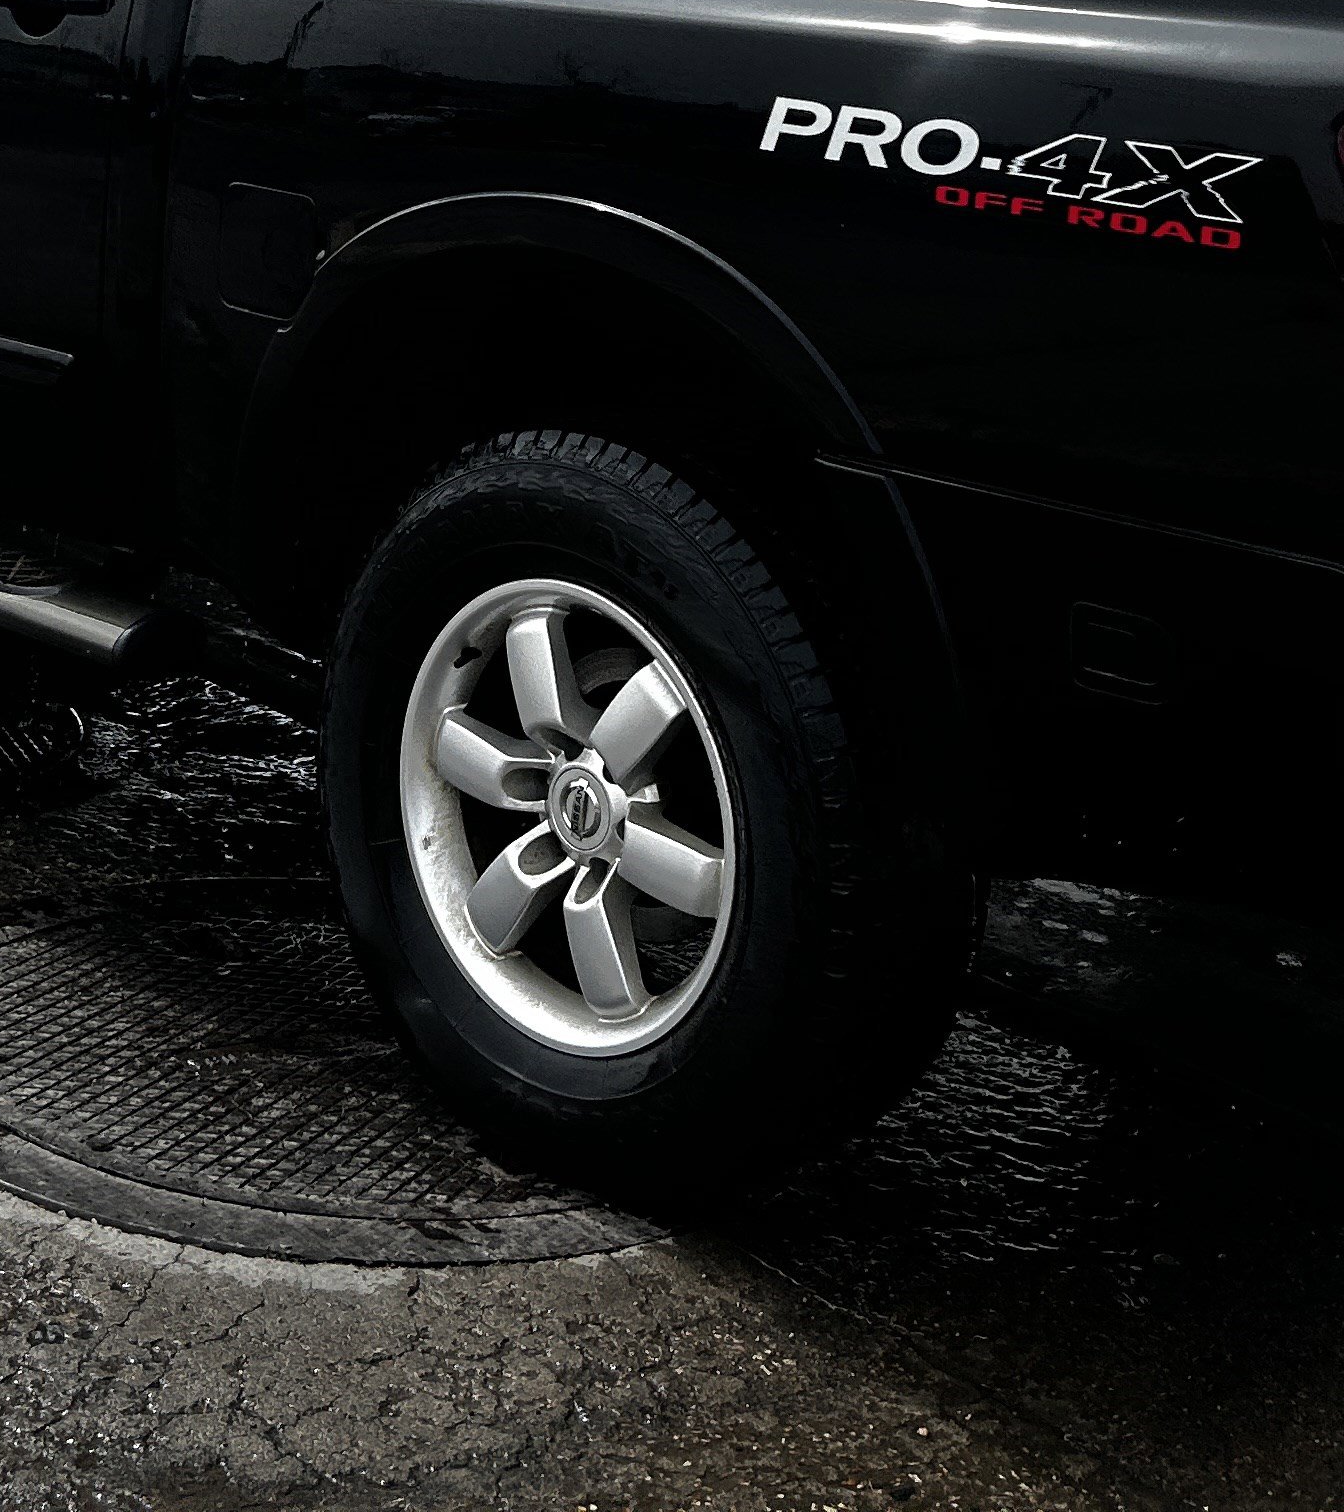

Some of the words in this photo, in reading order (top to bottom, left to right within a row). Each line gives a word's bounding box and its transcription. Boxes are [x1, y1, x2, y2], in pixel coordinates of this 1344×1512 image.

[760, 96, 1263, 224] PRO-4X
[935, 185, 1045, 216] OFF
[1067, 205, 1241, 249] ROAD
